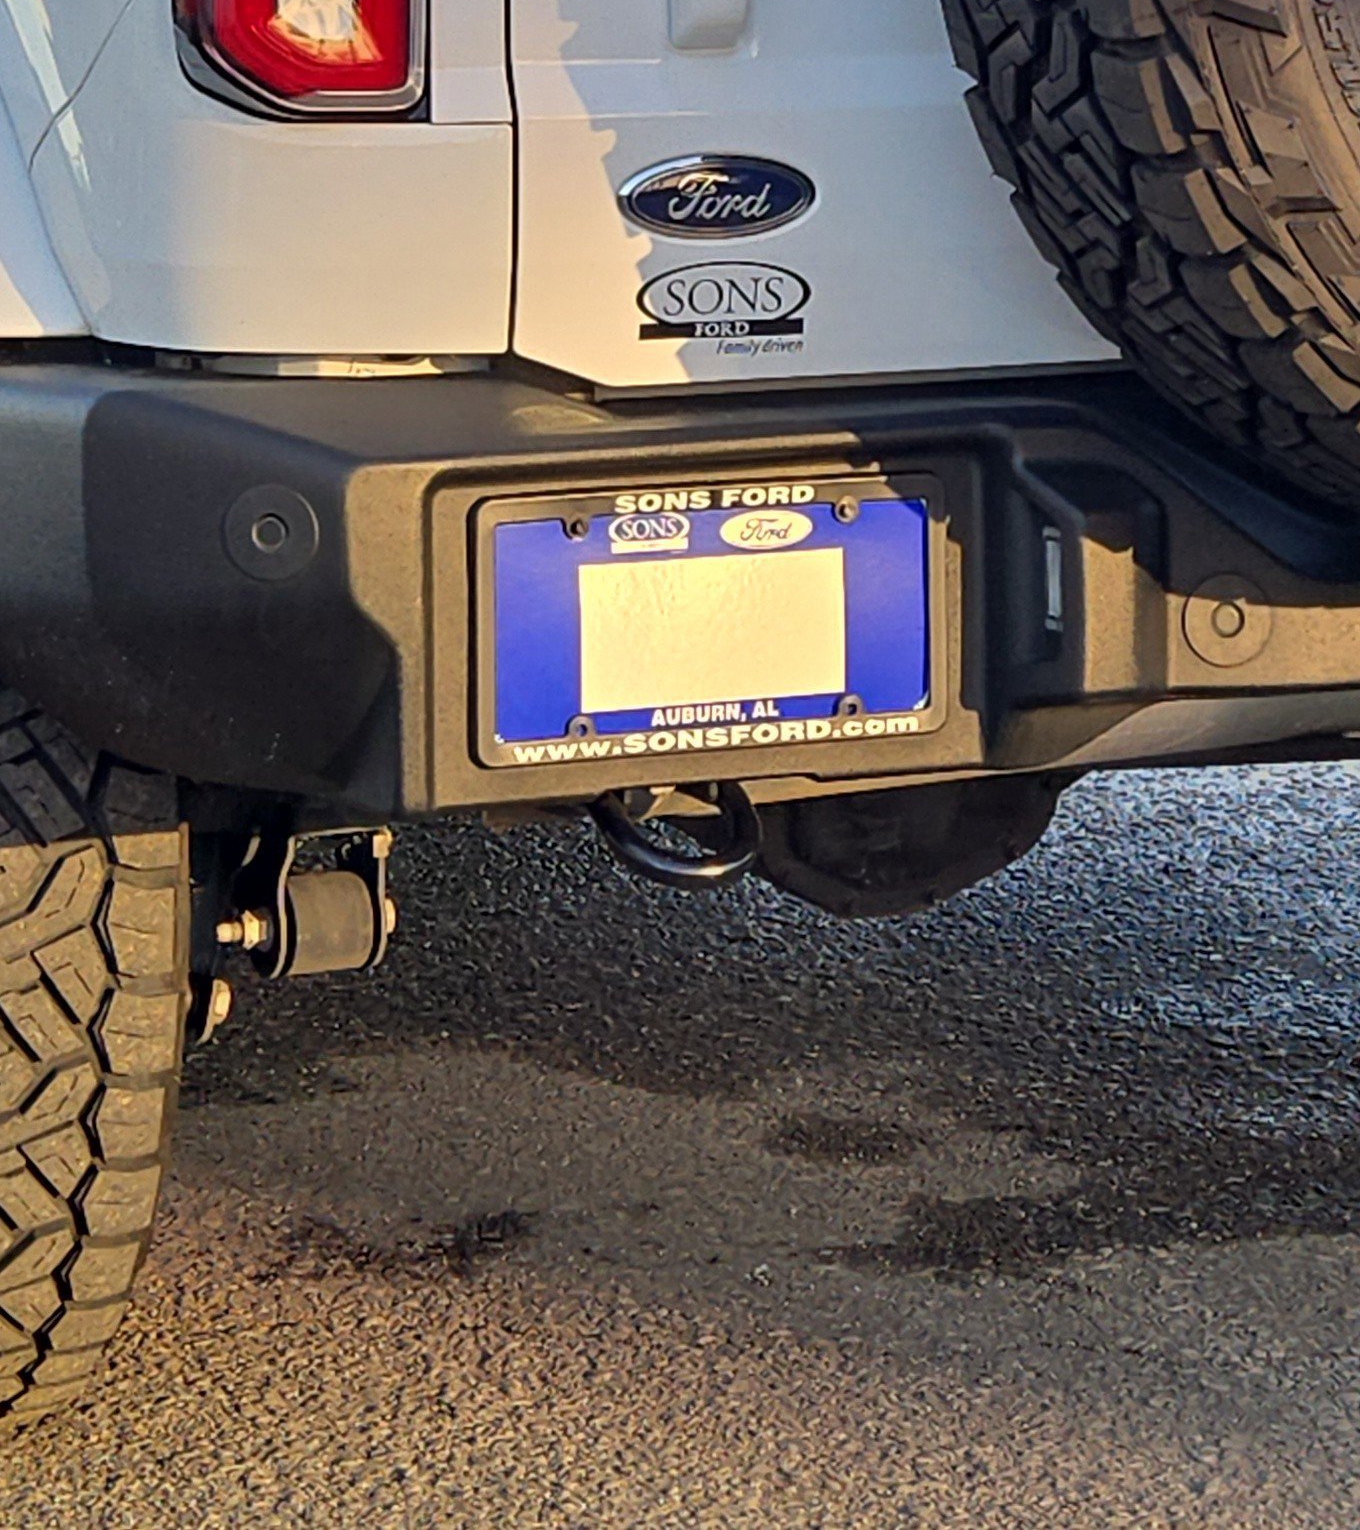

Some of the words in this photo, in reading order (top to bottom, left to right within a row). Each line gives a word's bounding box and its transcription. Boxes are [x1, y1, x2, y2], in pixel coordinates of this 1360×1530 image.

[668, 172, 771, 220] Ford
[663, 276, 785, 316] SONS
[694, 321, 750, 337] FORD
[614, 490, 712, 514] SONS
[721, 484, 815, 508] FORD
[620, 517, 678, 540] SONS
[740, 518, 793, 541] Ford
[651, 701, 747, 728] AUBURN,
[752, 699, 779, 719] AL
[513, 716, 919, 764] www.SONSFORD.com
